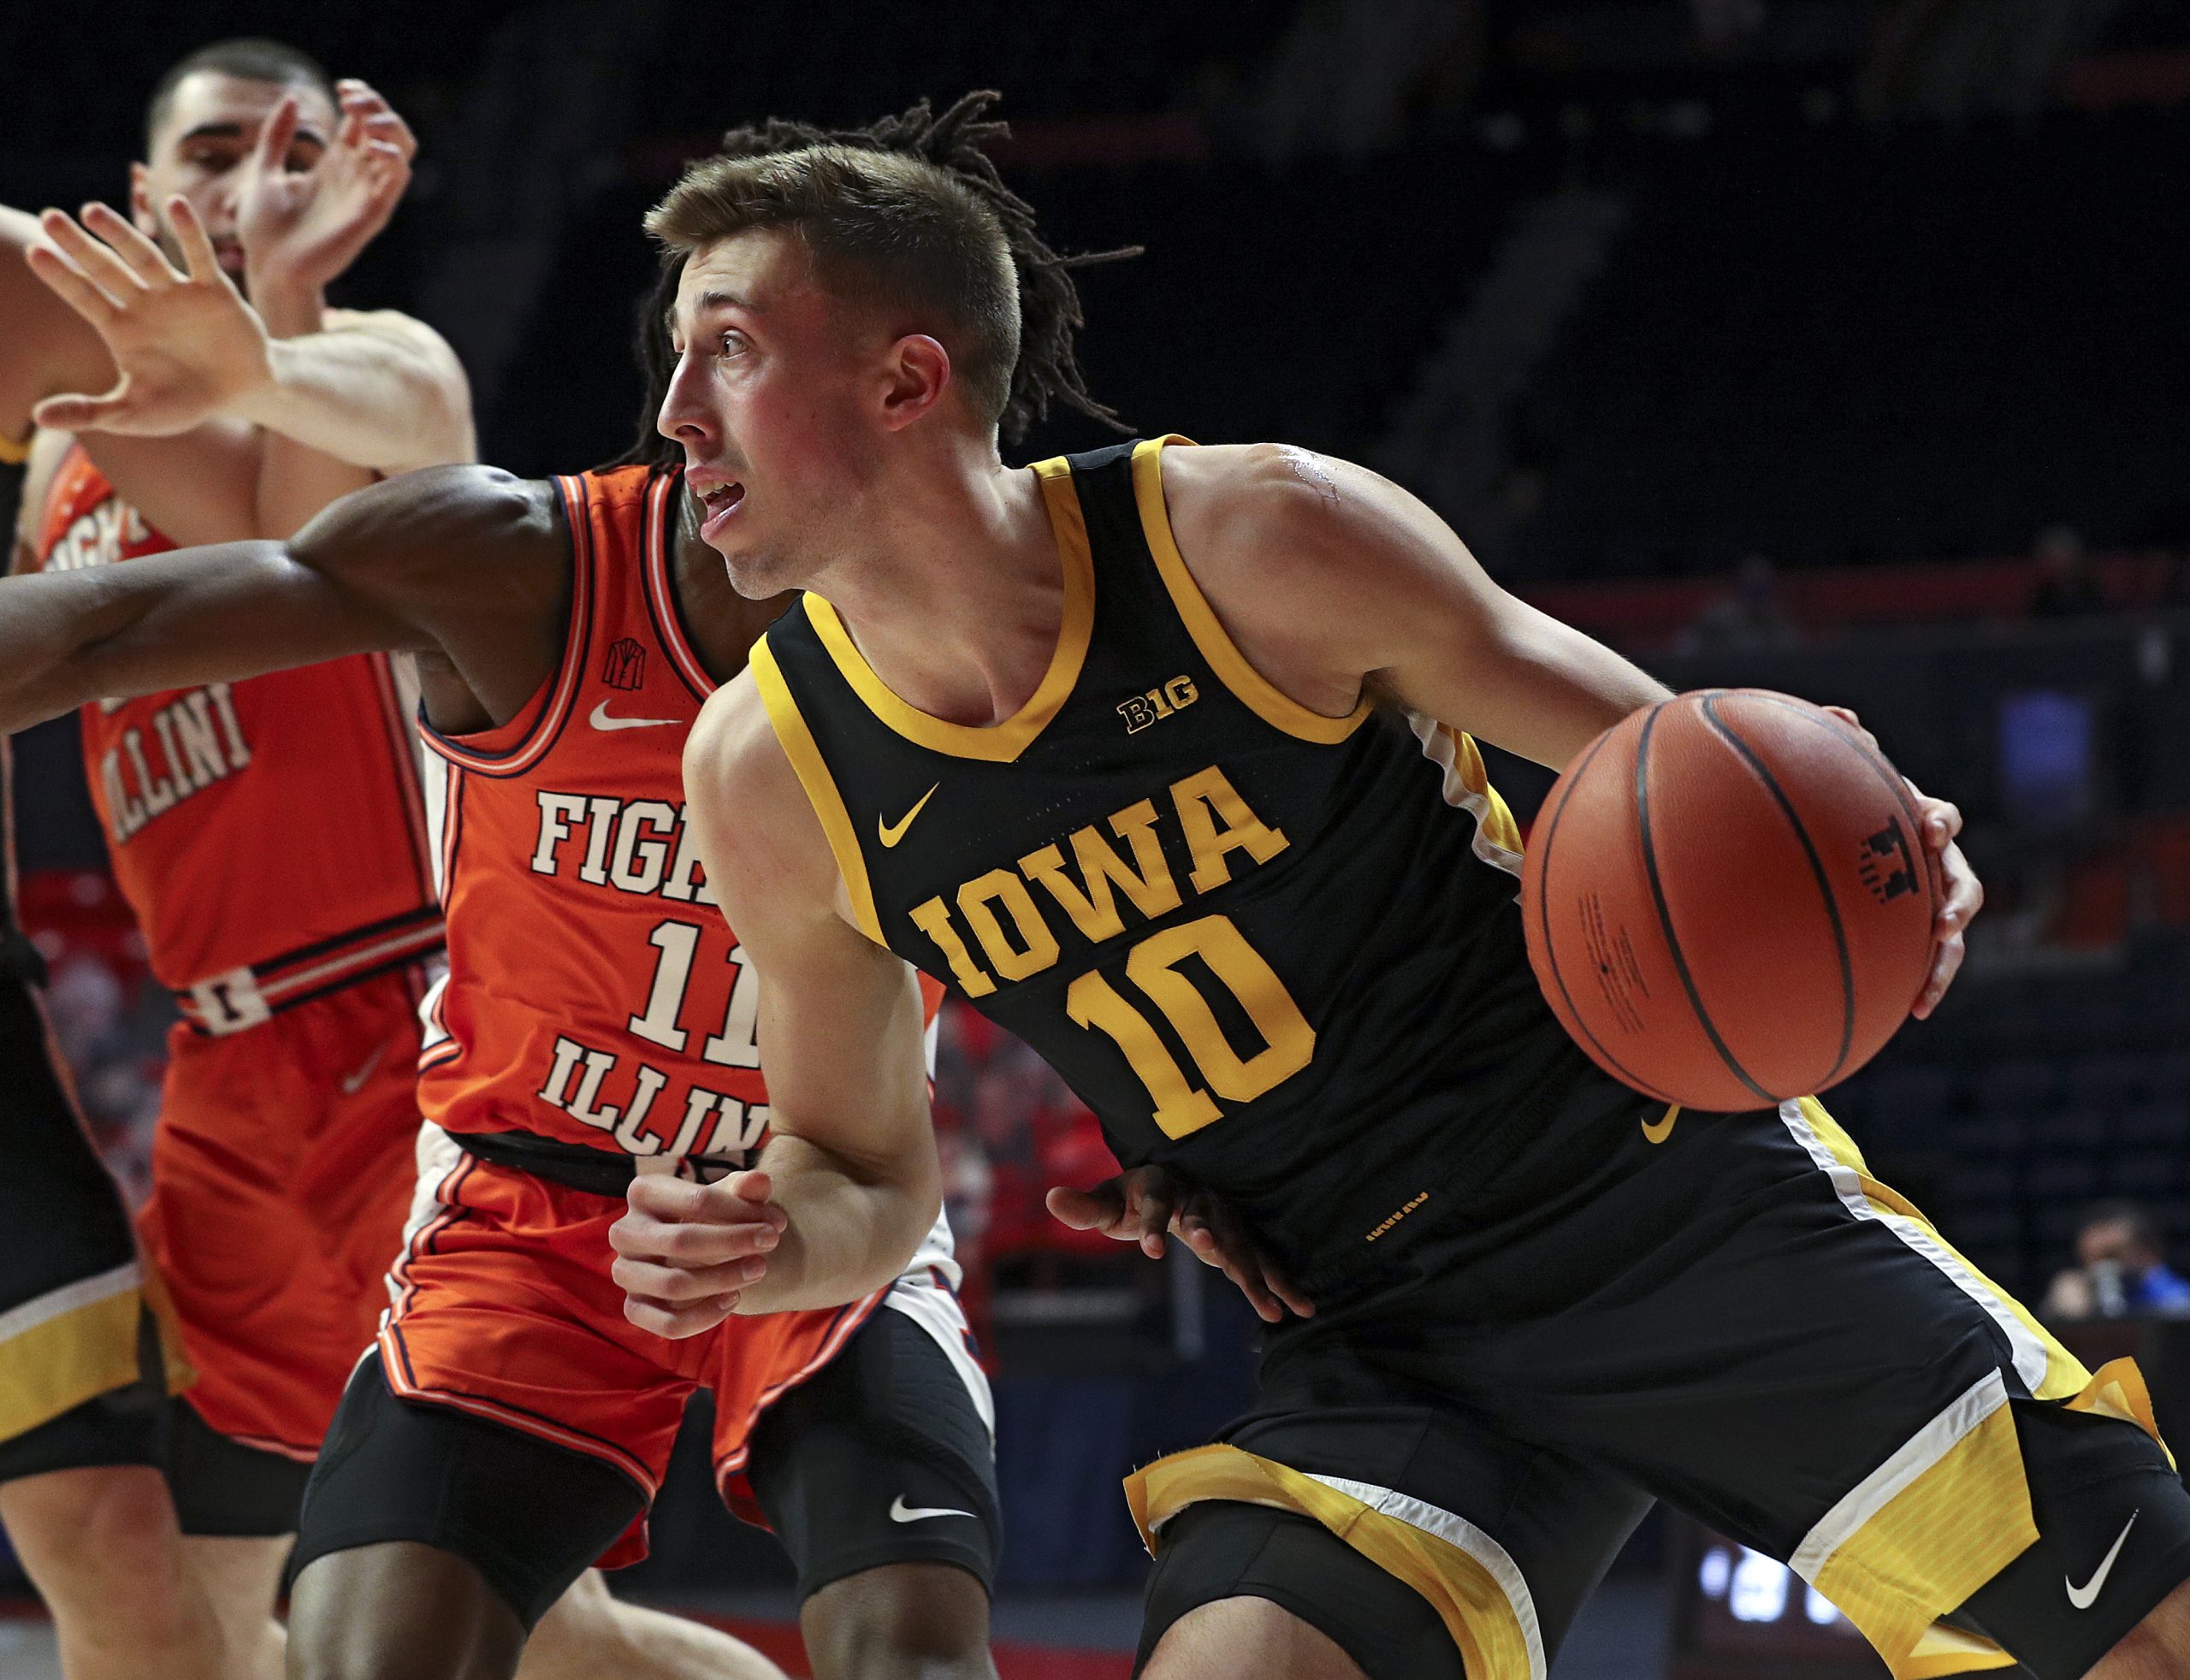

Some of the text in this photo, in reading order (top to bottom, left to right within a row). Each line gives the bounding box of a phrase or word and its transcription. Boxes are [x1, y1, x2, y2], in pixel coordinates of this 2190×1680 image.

[628, 919, 761, 1069] 11
[909, 765, 1290, 998] IOWA
[1066, 914, 1317, 1140] 10
